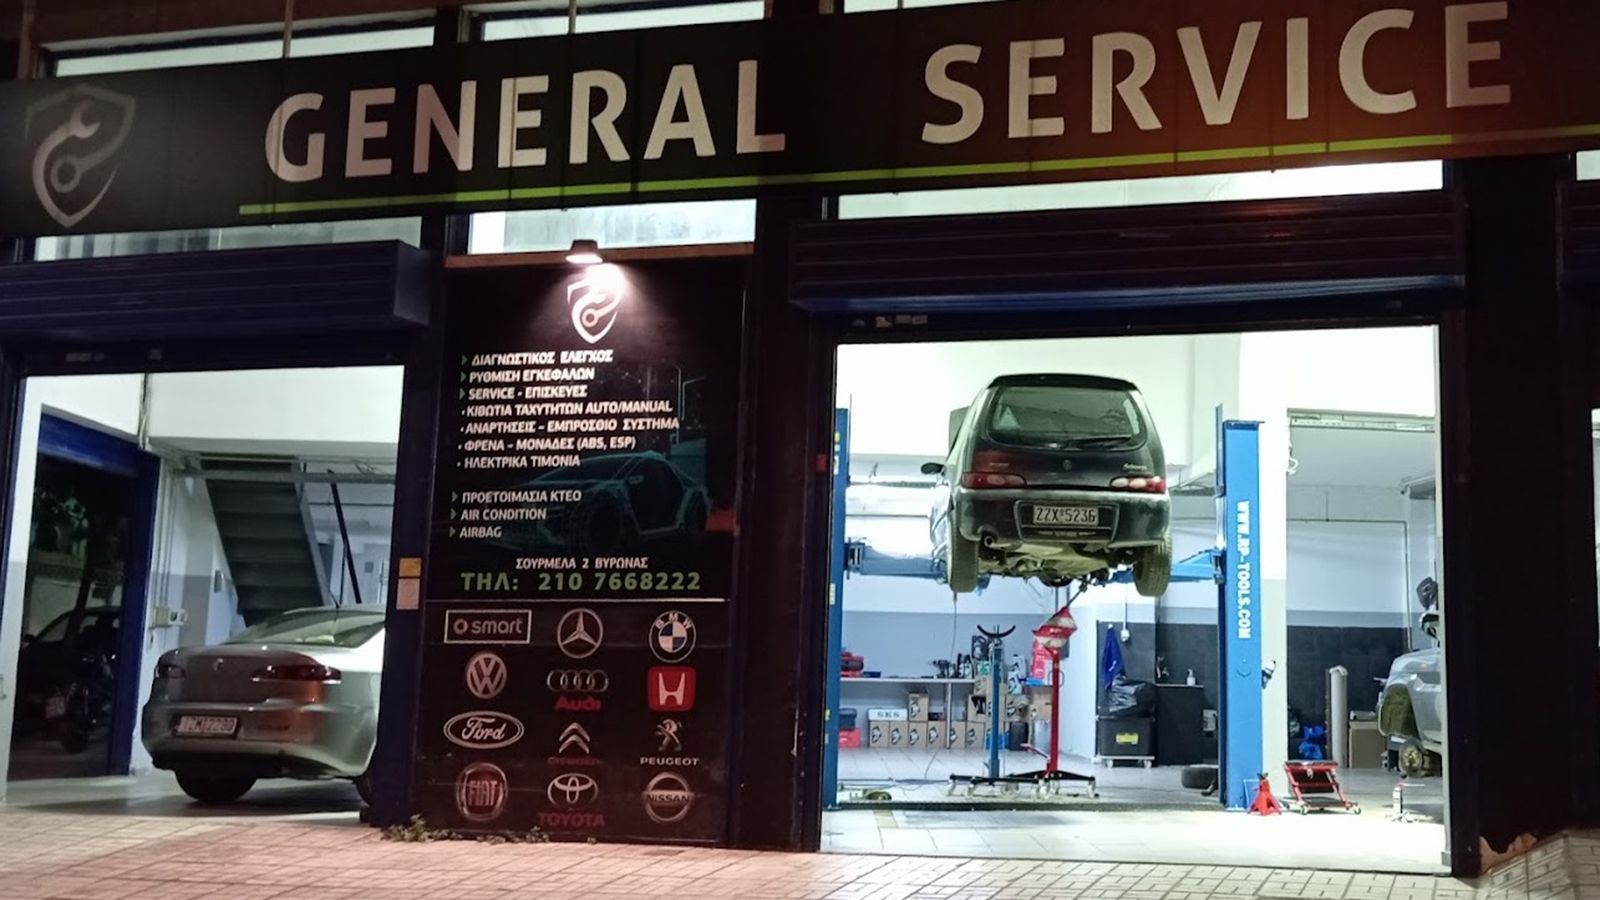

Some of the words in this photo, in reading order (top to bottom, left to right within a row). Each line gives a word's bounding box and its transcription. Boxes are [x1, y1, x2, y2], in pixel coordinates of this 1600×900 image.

[265, 59, 786, 182] GENERAL
[921, 1, 1511, 145] SERVICE
[472, 352, 555, 366] ΔΙΑΓΝΩΣΤΙΚΟΣ
[469, 370, 520, 383] ΡΥΘΜΙΣΗ
[523, 368, 595, 381] ΕΓΚΕΦΑΛΩΝ
[468, 387, 515, 400] SERVICE
[525, 385, 587, 398] ΕΠΙΣΚΕΥΕΣ
[467, 405, 512, 417] ΚΙΒΩΤΙΑ
[515, 403, 583, 415] ΤΑΧΥΤΗΤΩΝ
[585, 401, 673, 414] AUTO/MANUAL
[465, 421, 536, 434] ΑΝΑΡΤΗΣΕΙΣ
[547, 419, 617, 432] ΕΜΠΡΟΣΘΙΟ
[623, 418, 679, 430] ΣΥΣΤΗΜΑ
[465, 439, 505, 451] ΦΡΕΝΑ
[516, 437, 575, 450] ΜΟΝΑΔΕΣ
[577, 437, 607, 450] (ABS,
[610, 435, 636, 449] ESP)
[464, 456, 527, 468] ΗΛΕΚΤΡΙΚΑ
[530, 454, 580, 467] ΤΙΜΟΝΙΑ
[462, 491, 548, 504] ΠΡΟΕΤΟΙΜΑΣΙΑ
[550, 490, 582, 502] ΚΤΕΟ
[461, 509, 480, 521] AIR
[483, 508, 547, 520] CONDITION
[1066, 508, 1096, 522] 5236
[459, 526, 502, 538] AIRBAG
[516, 558, 576, 569] ΣΟΥΡΜΕΛΑ
[582, 558, 589, 568] 2
[595, 557, 648, 568] ΒΥΡΩΝΑΣ
[461, 573, 519, 591] ΤΗΛ:
[538, 573, 583, 591] 210
[594, 572, 700, 590] 7668222
[472, 618, 523, 634] smart
[655, 612, 692, 630] BMW
[461, 716, 506, 740] Ford
[640, 757, 699, 766] PEUGEOT
[468, 780, 497, 806] FIAT
[648, 794, 691, 802] NISSAN
[538, 812, 606, 828] TOYOTA
